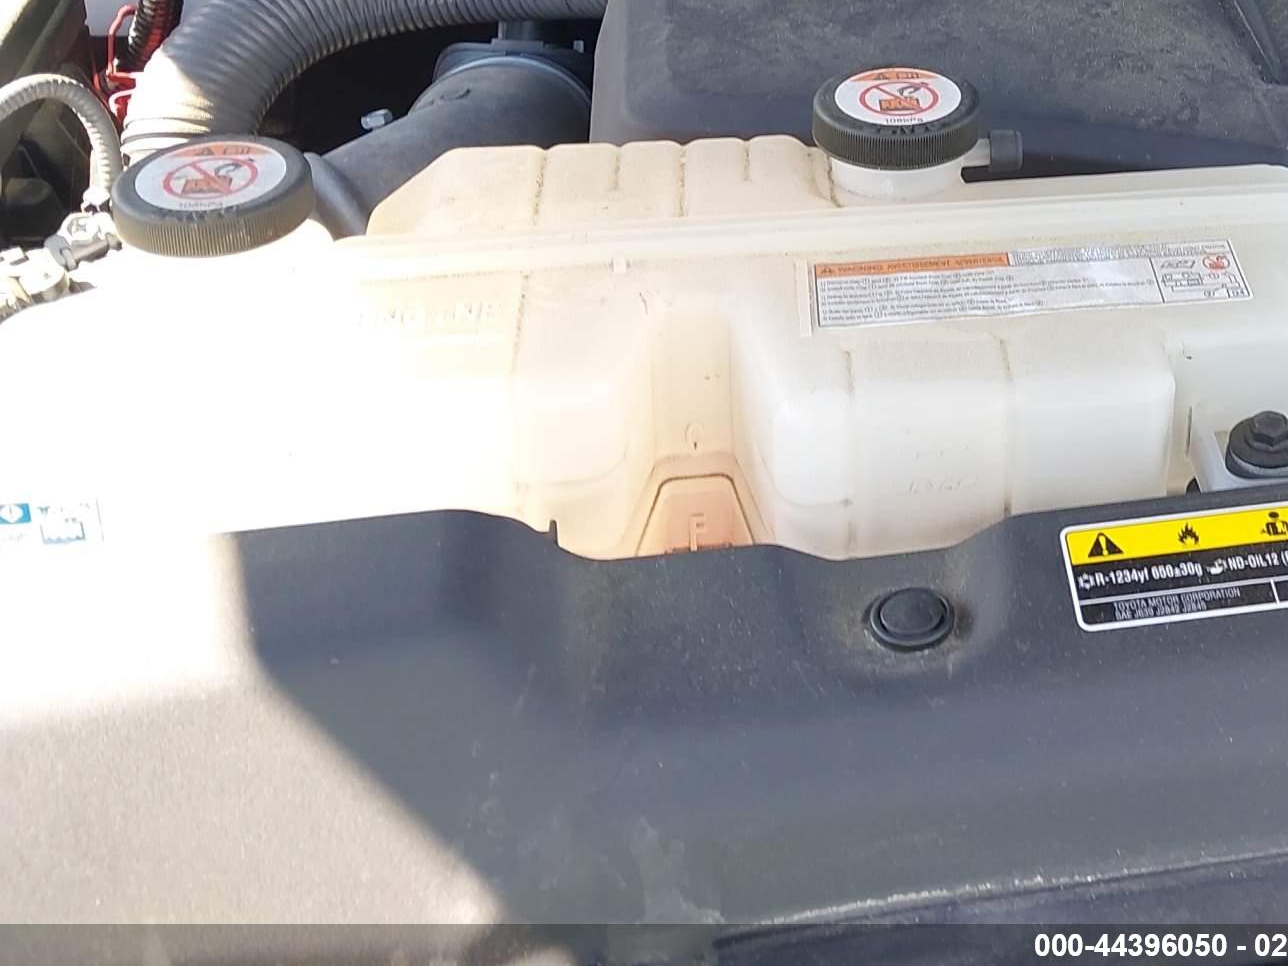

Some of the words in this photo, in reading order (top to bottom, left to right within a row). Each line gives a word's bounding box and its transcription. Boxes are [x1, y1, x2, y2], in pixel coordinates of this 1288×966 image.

[1095, 567, 1149, 587] R-1234yf
[1113, 599, 1147, 613] TOYOTA
[1147, 595, 1181, 609] MOTOR
